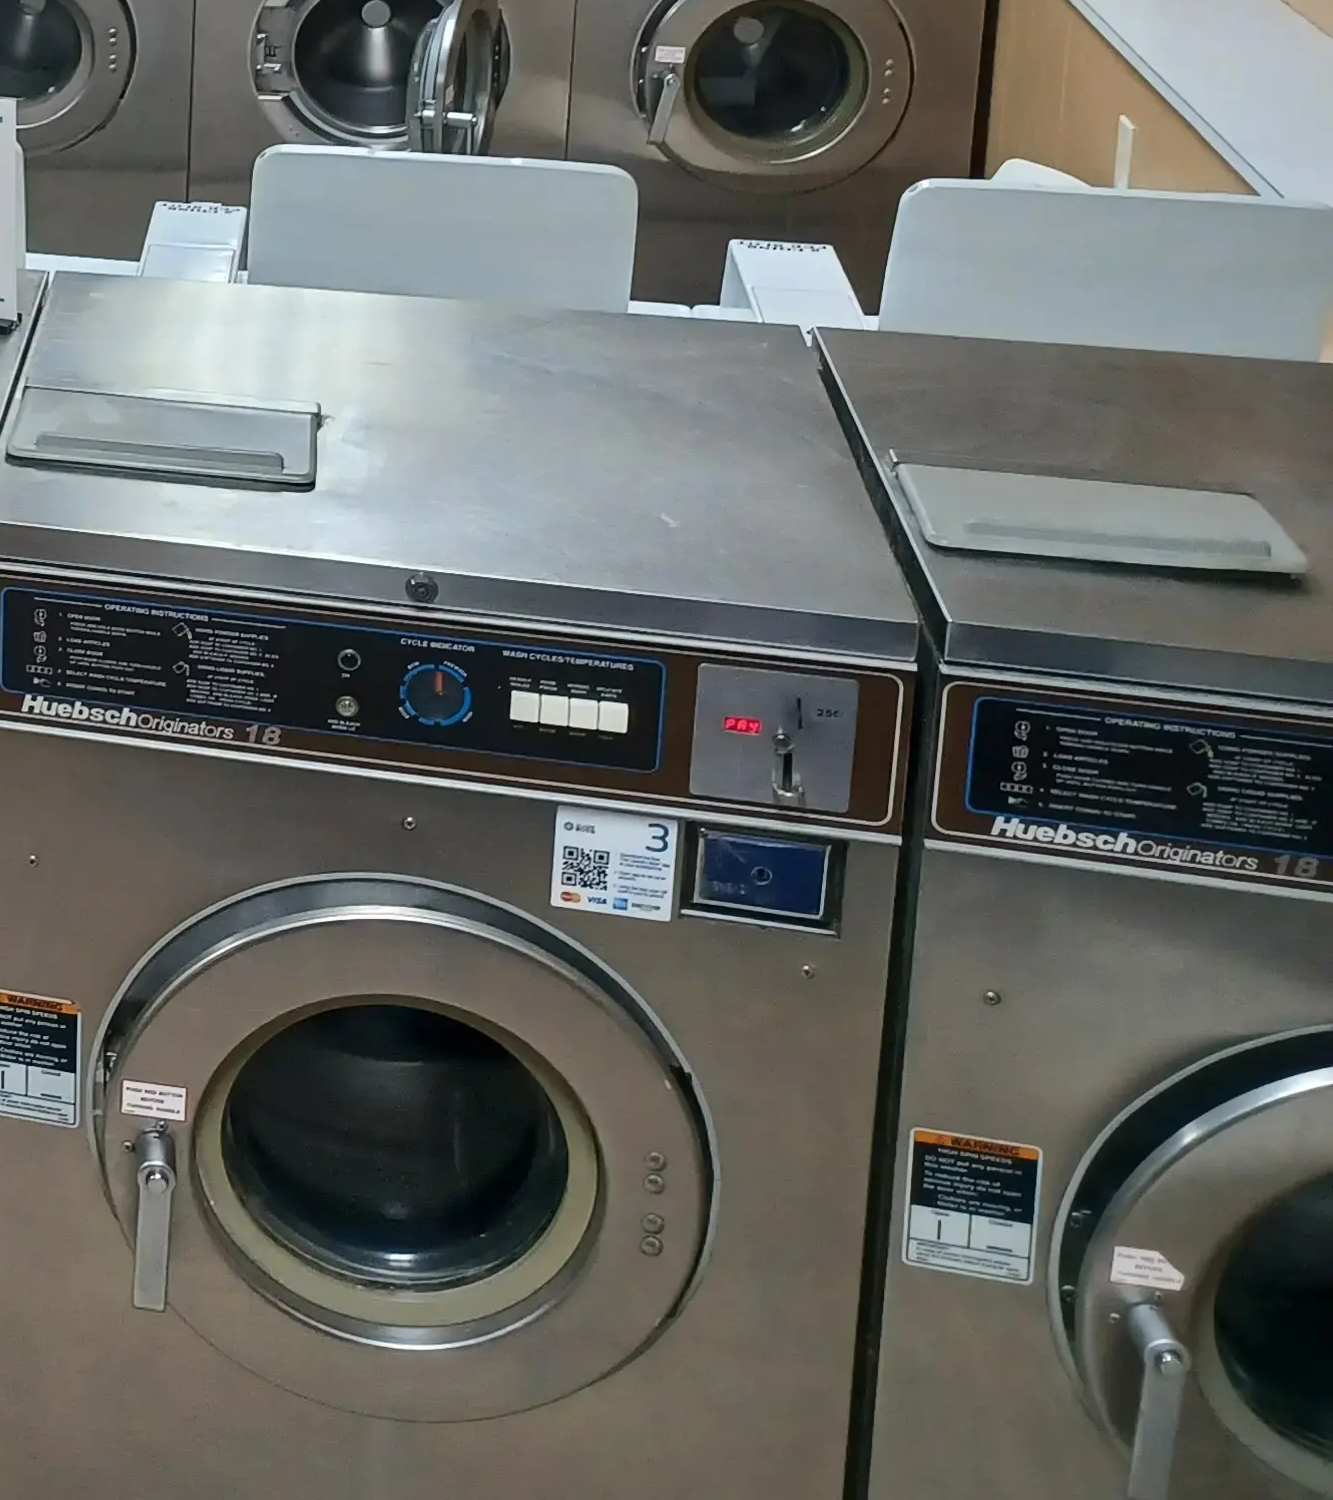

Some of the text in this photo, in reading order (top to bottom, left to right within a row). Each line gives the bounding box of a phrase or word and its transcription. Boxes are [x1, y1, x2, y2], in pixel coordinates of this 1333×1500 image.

[104, 602, 210, 623] OPERATING INSTRUCTIONS
[400, 637, 476, 654] CYCLE INDICATOR
[502, 649, 528, 660] WASH
[724, 717, 760, 734] PAY
[1104, 716, 1237, 739] OPERATING INSTRUCTIONS
[244, 724, 282, 747] 18
[645, 823, 670, 853] 3
[1273, 854, 1321, 878] 18
[587, 895, 607, 905] VISA
[5, 994, 64, 1012] WARNING
[950, 1136, 1021, 1157] WARNING
[938, 1147, 1013, 1166] HIGH SPIN SPEEDS
[939, 1157, 955, 1166] NOT
